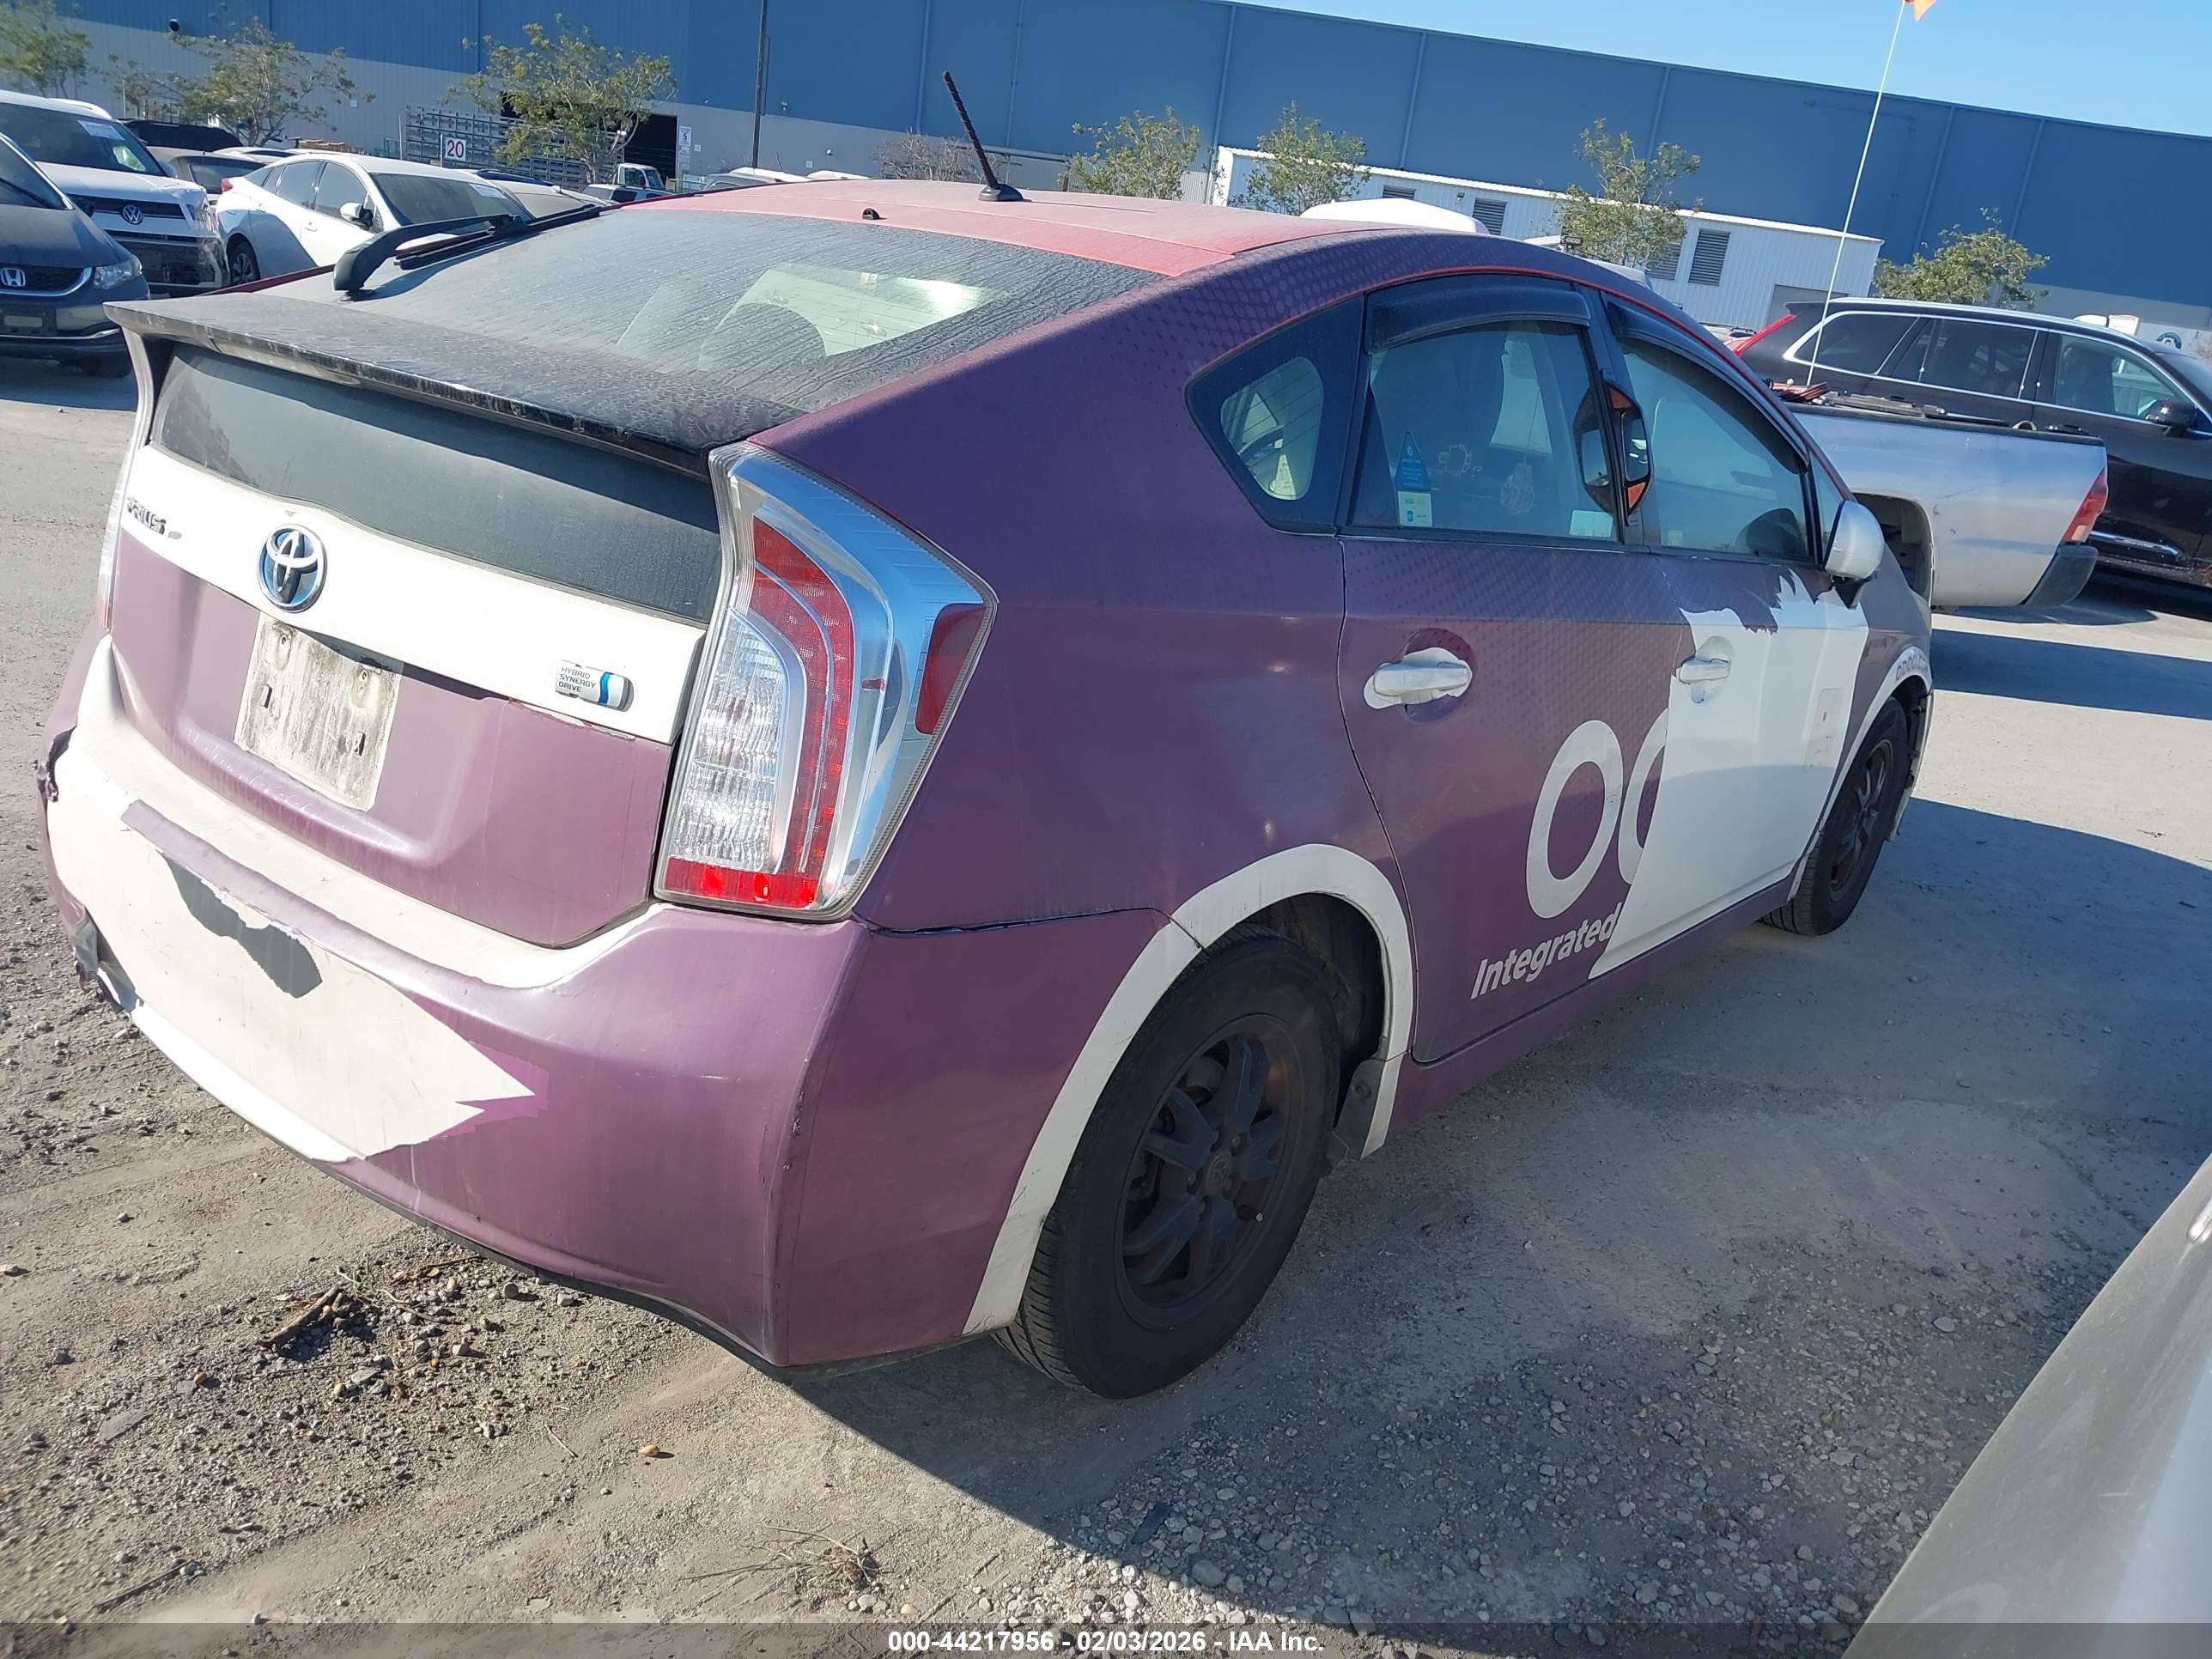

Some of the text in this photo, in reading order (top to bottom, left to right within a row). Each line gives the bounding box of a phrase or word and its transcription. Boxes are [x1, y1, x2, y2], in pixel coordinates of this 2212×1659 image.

[447, 139, 465, 159] 20
[561, 666, 591, 679] HYBRID
[558, 681, 582, 693] DRIVE
[559, 673, 596, 690] SYNERGY
[1469, 901, 1622, 1000] Integrated
